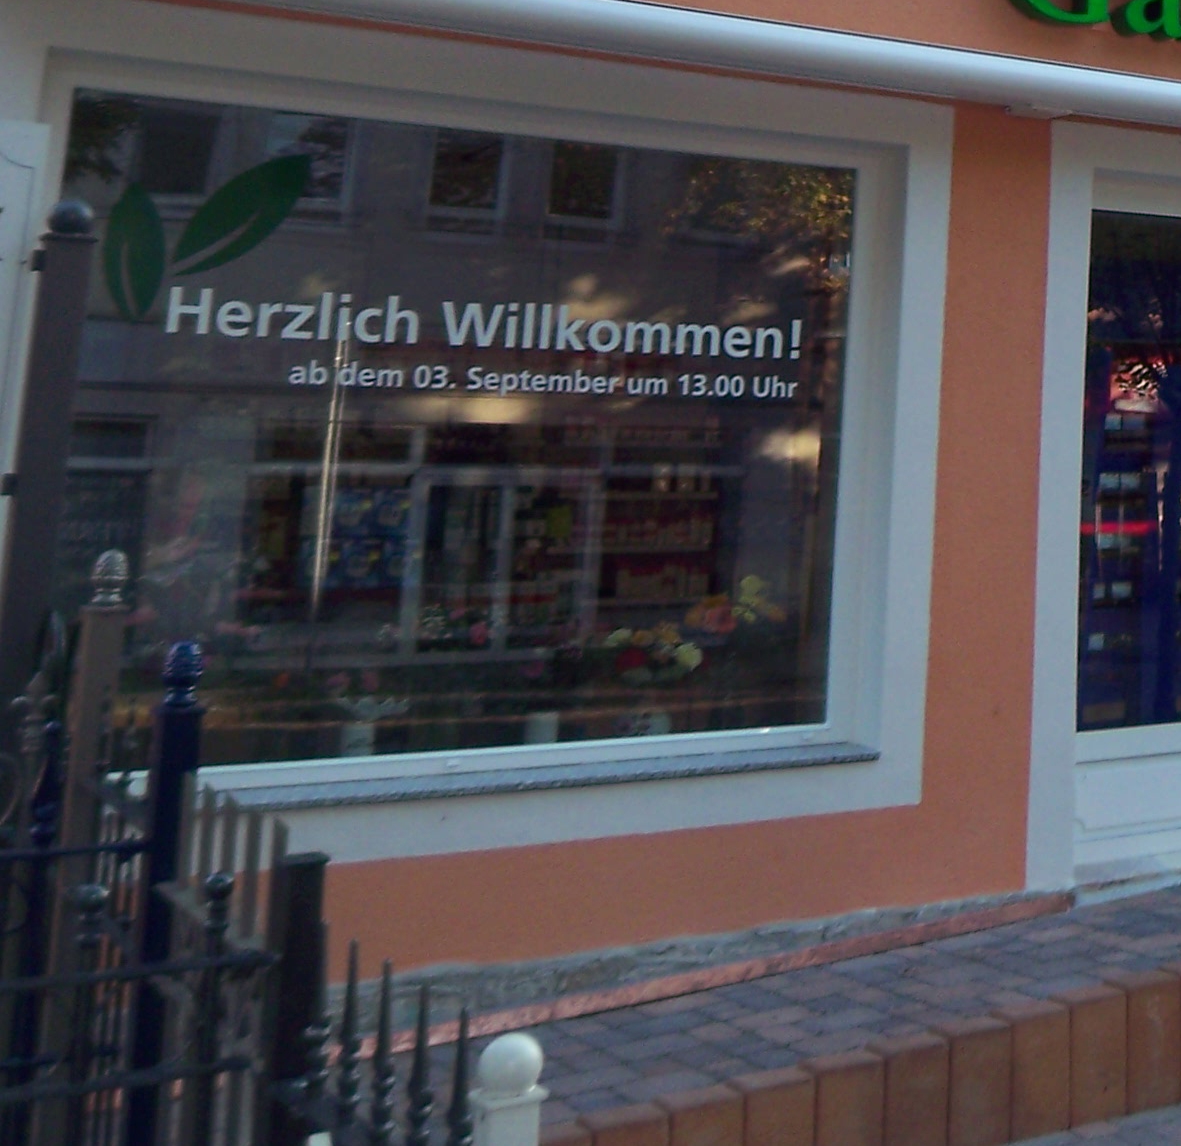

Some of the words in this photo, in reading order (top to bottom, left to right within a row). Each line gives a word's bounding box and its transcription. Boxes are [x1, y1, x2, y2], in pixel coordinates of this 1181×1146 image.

[165, 286, 420, 345] Herzlich
[442, 301, 803, 360] Willkommen!
[288, 359, 328, 386] ab
[338, 360, 405, 388] dem
[413, 364, 457, 390] 03.
[466, 366, 620, 397] September
[627, 375, 669, 396] um
[677, 373, 746, 398] 13.00
[752, 375, 799, 399] Uhr
